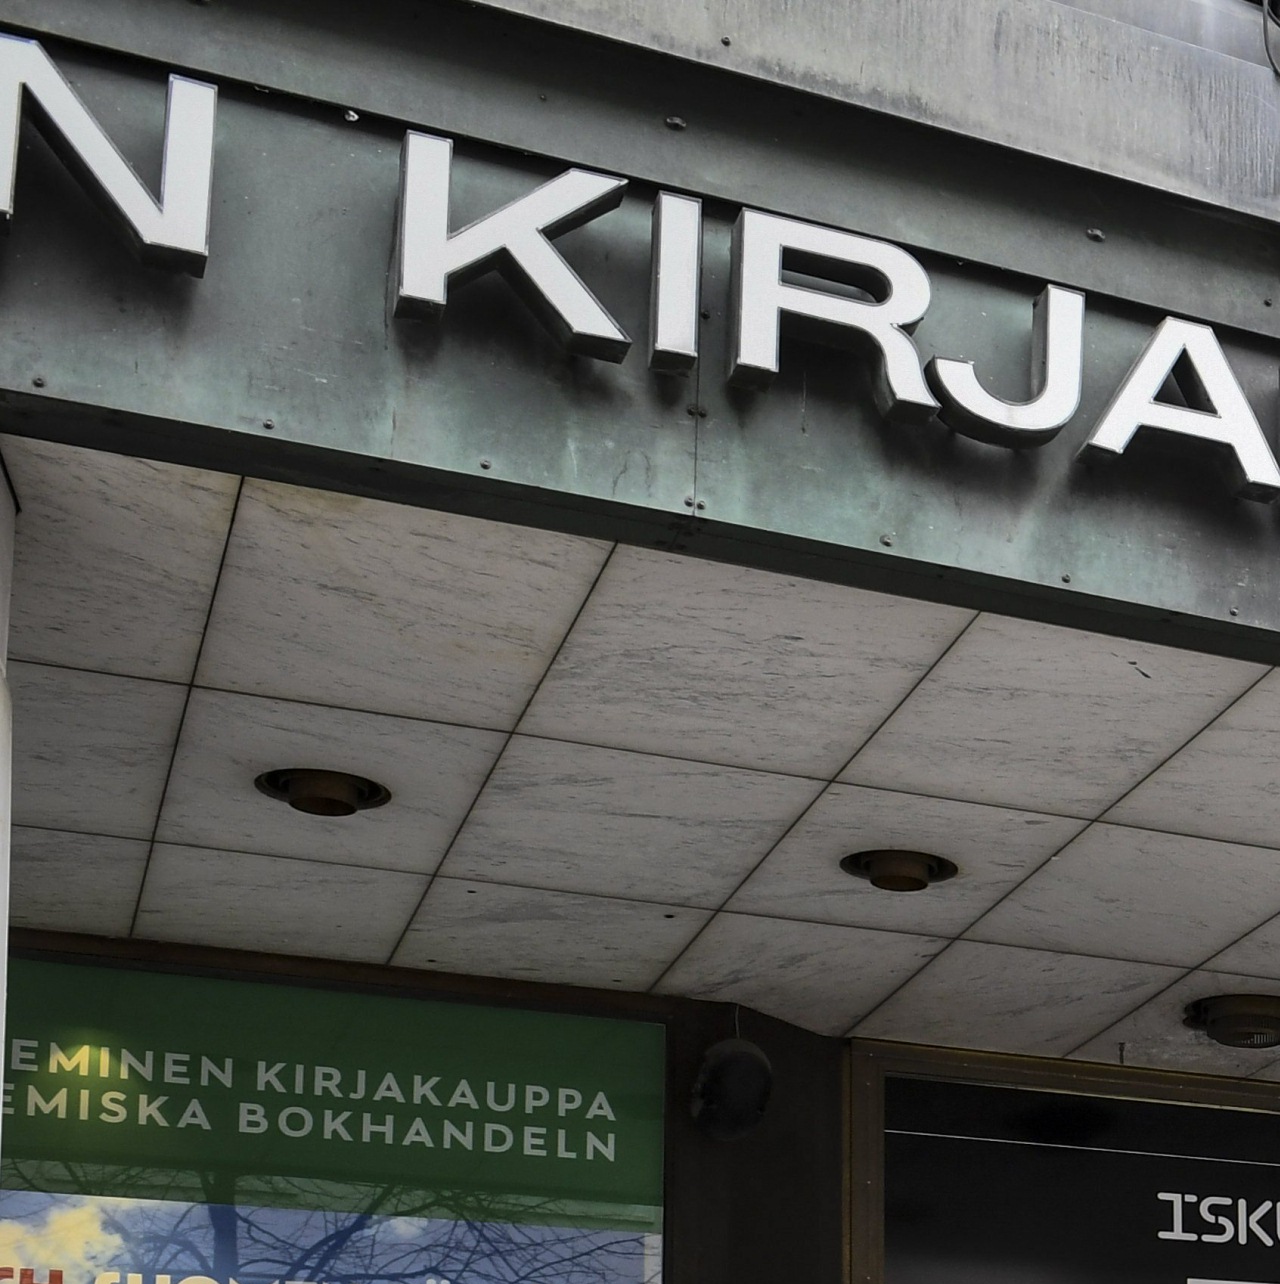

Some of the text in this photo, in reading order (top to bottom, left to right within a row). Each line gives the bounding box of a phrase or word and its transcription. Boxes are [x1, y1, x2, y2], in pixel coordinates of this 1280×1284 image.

[11, 1038, 617, 1121] EMINEN KIRJAKAUPPA
[239, 1102, 616, 1162] BOKHANDELN
